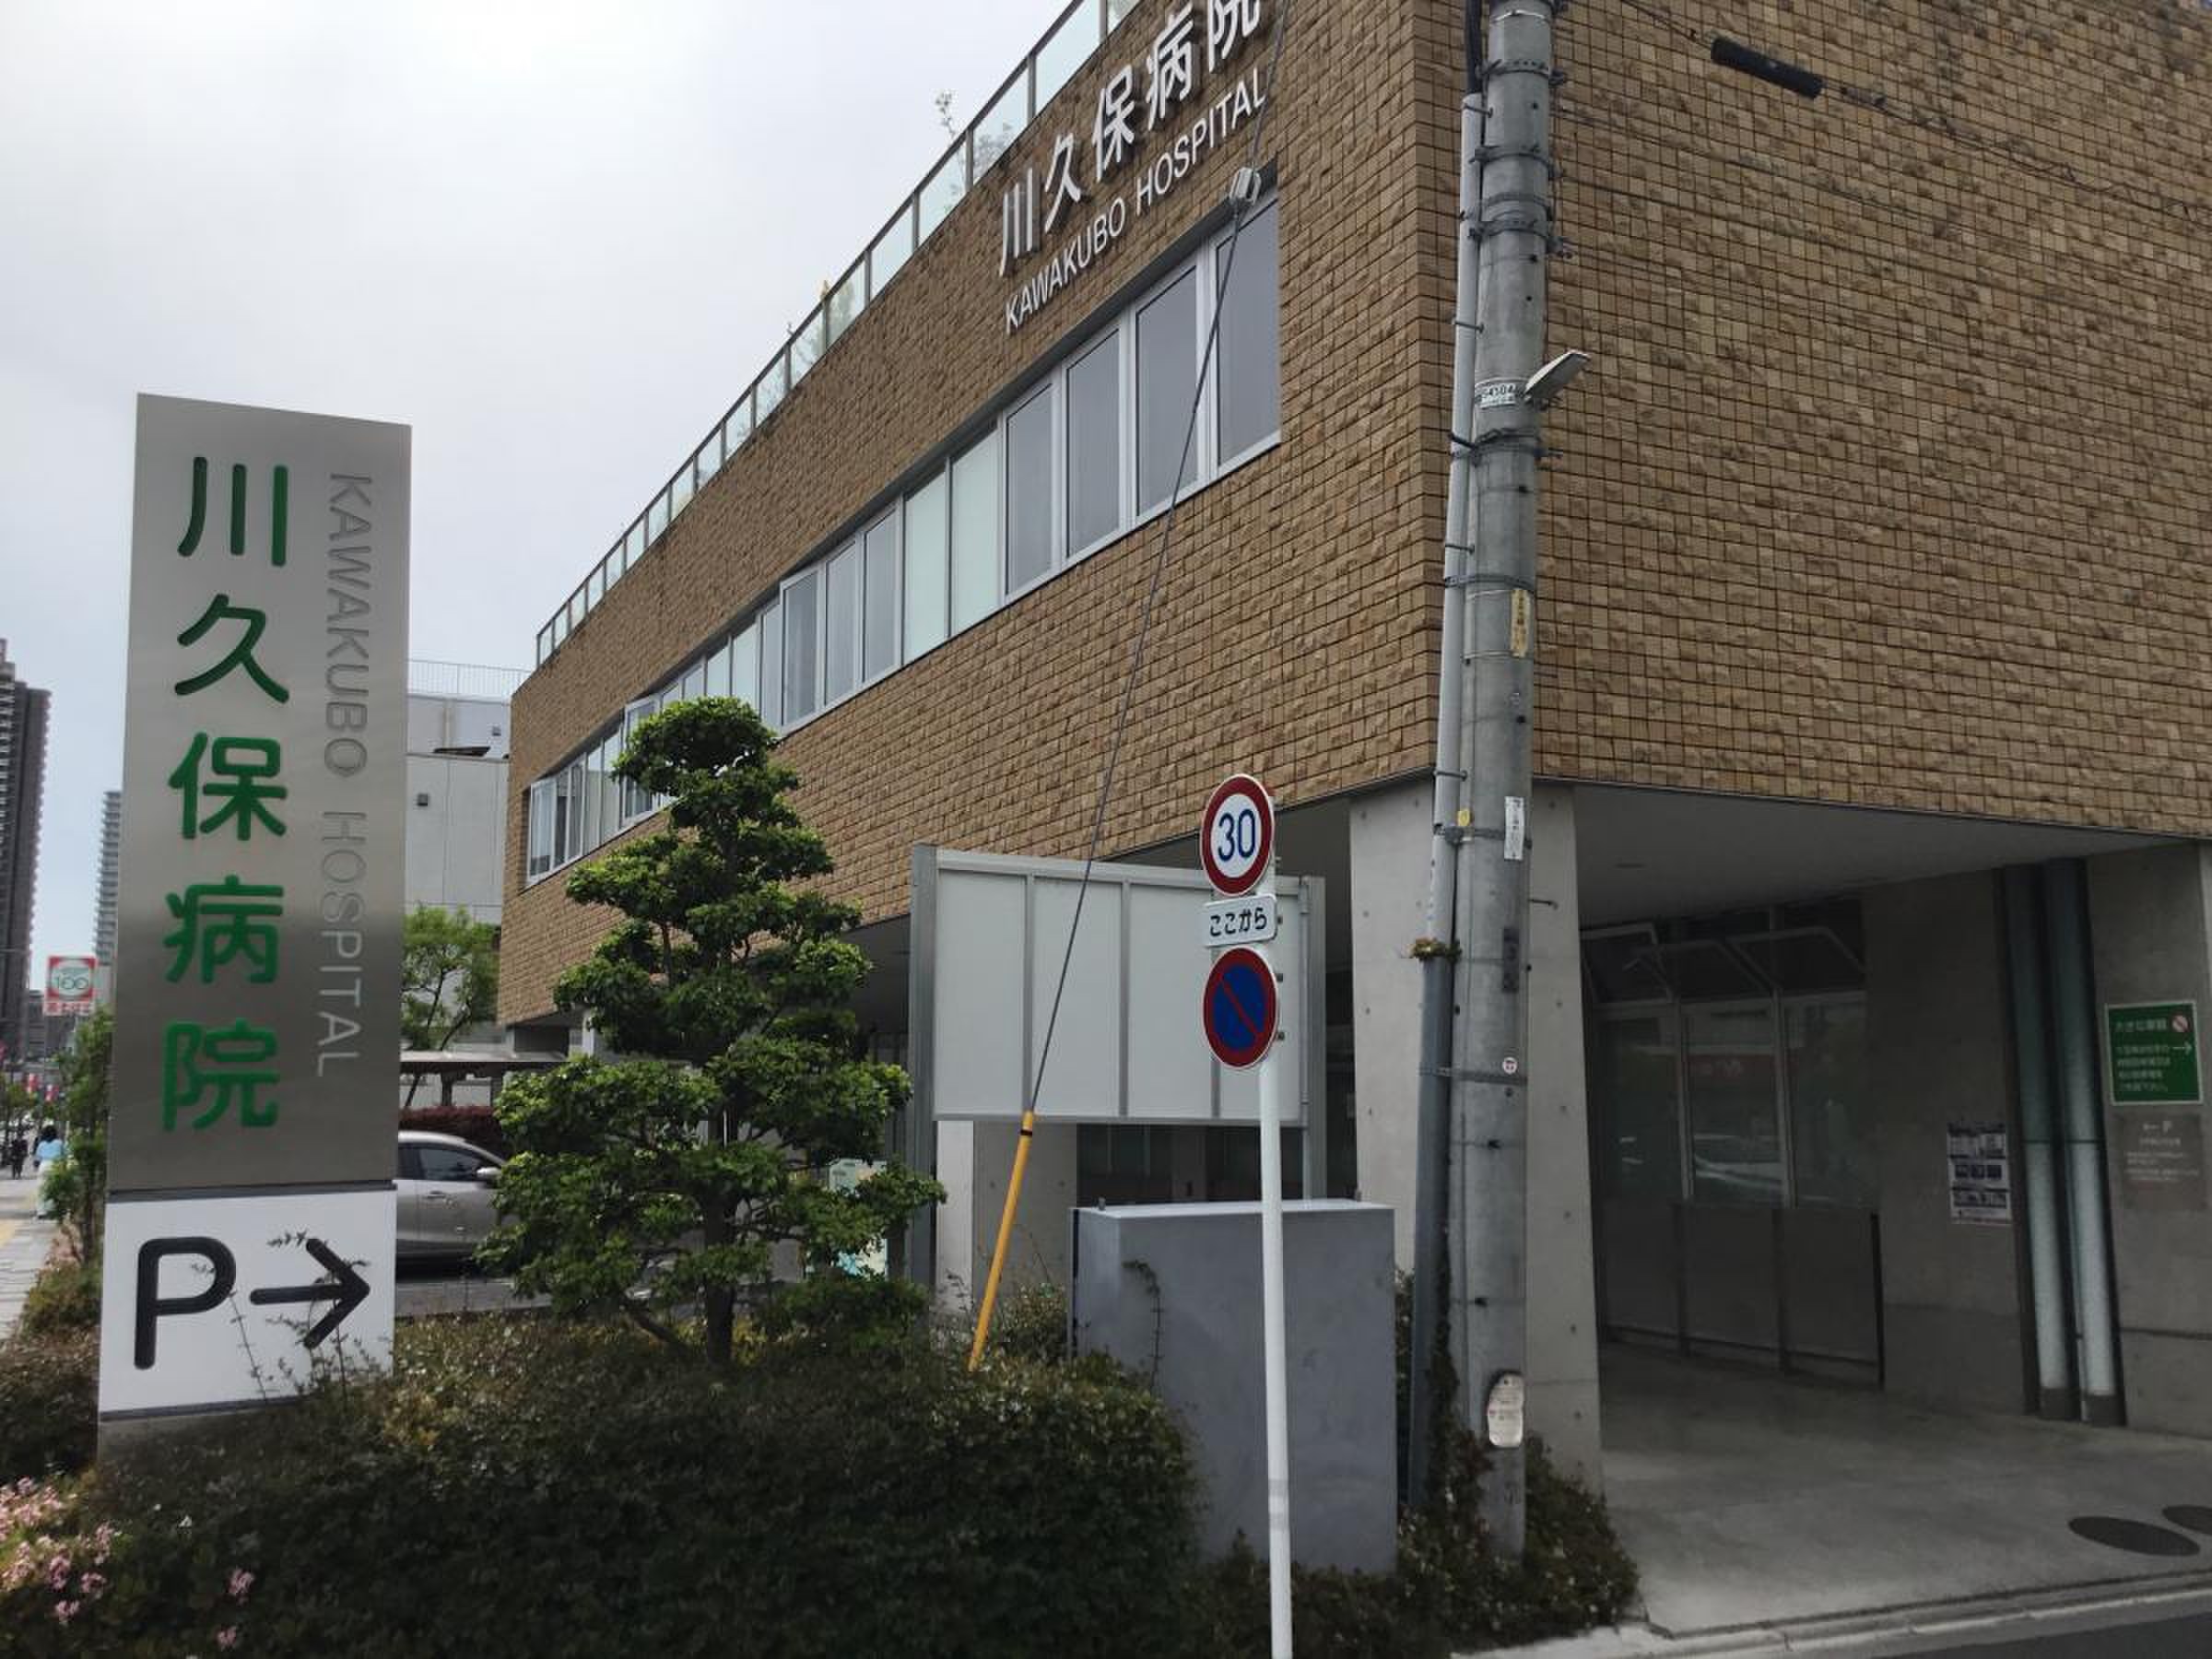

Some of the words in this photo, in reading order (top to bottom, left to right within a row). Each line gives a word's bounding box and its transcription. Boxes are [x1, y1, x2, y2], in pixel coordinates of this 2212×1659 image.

[1005, 196, 1126, 335] KAWAKUBO
[1135, 67, 1267, 217] HOSPITAL
[324, 473, 372, 777] KAWAKUBO
[163, 456, 289, 1134] 川久保病院
[1210, 908, 1267, 936] ここから
[1218, 809, 1255, 862] 30
[317, 811, 366, 1077] HOSPITAL
[133, 1236, 237, 1371] P
